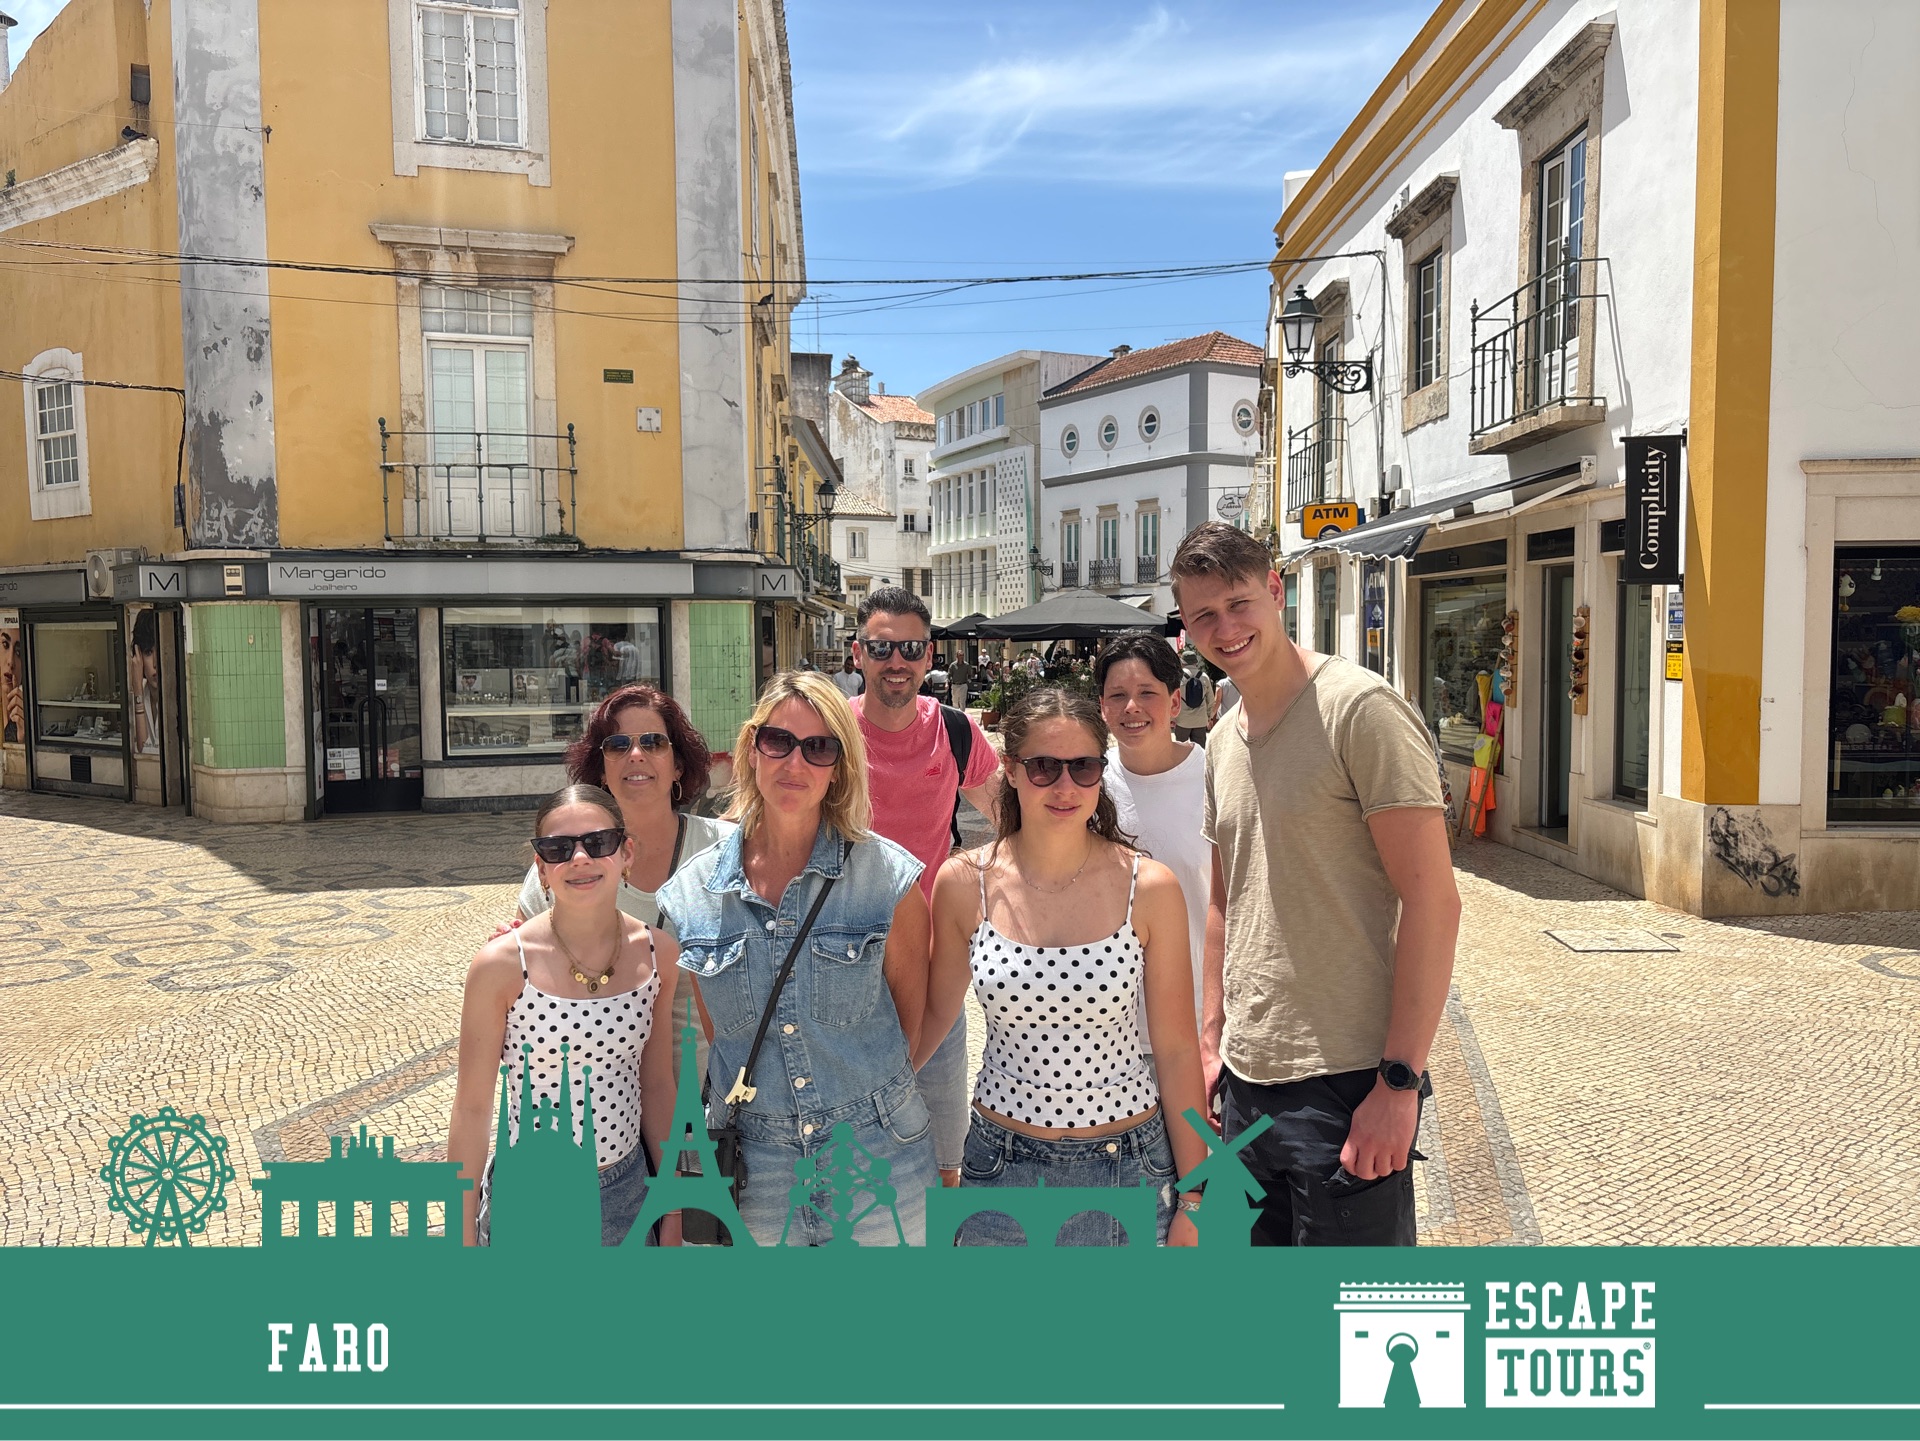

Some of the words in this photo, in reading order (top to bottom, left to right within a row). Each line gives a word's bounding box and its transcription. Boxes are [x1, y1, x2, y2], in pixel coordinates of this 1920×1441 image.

[1312, 507, 1349, 520] ATM
[1638, 445, 1668, 570] Complicity
[149, 571, 180, 592] M
[279, 565, 387, 582] Margarido
[1368, 570, 1385, 589] ATM
[308, 583, 358, 591] Joalheiro
[761, 574, 786, 591] M
